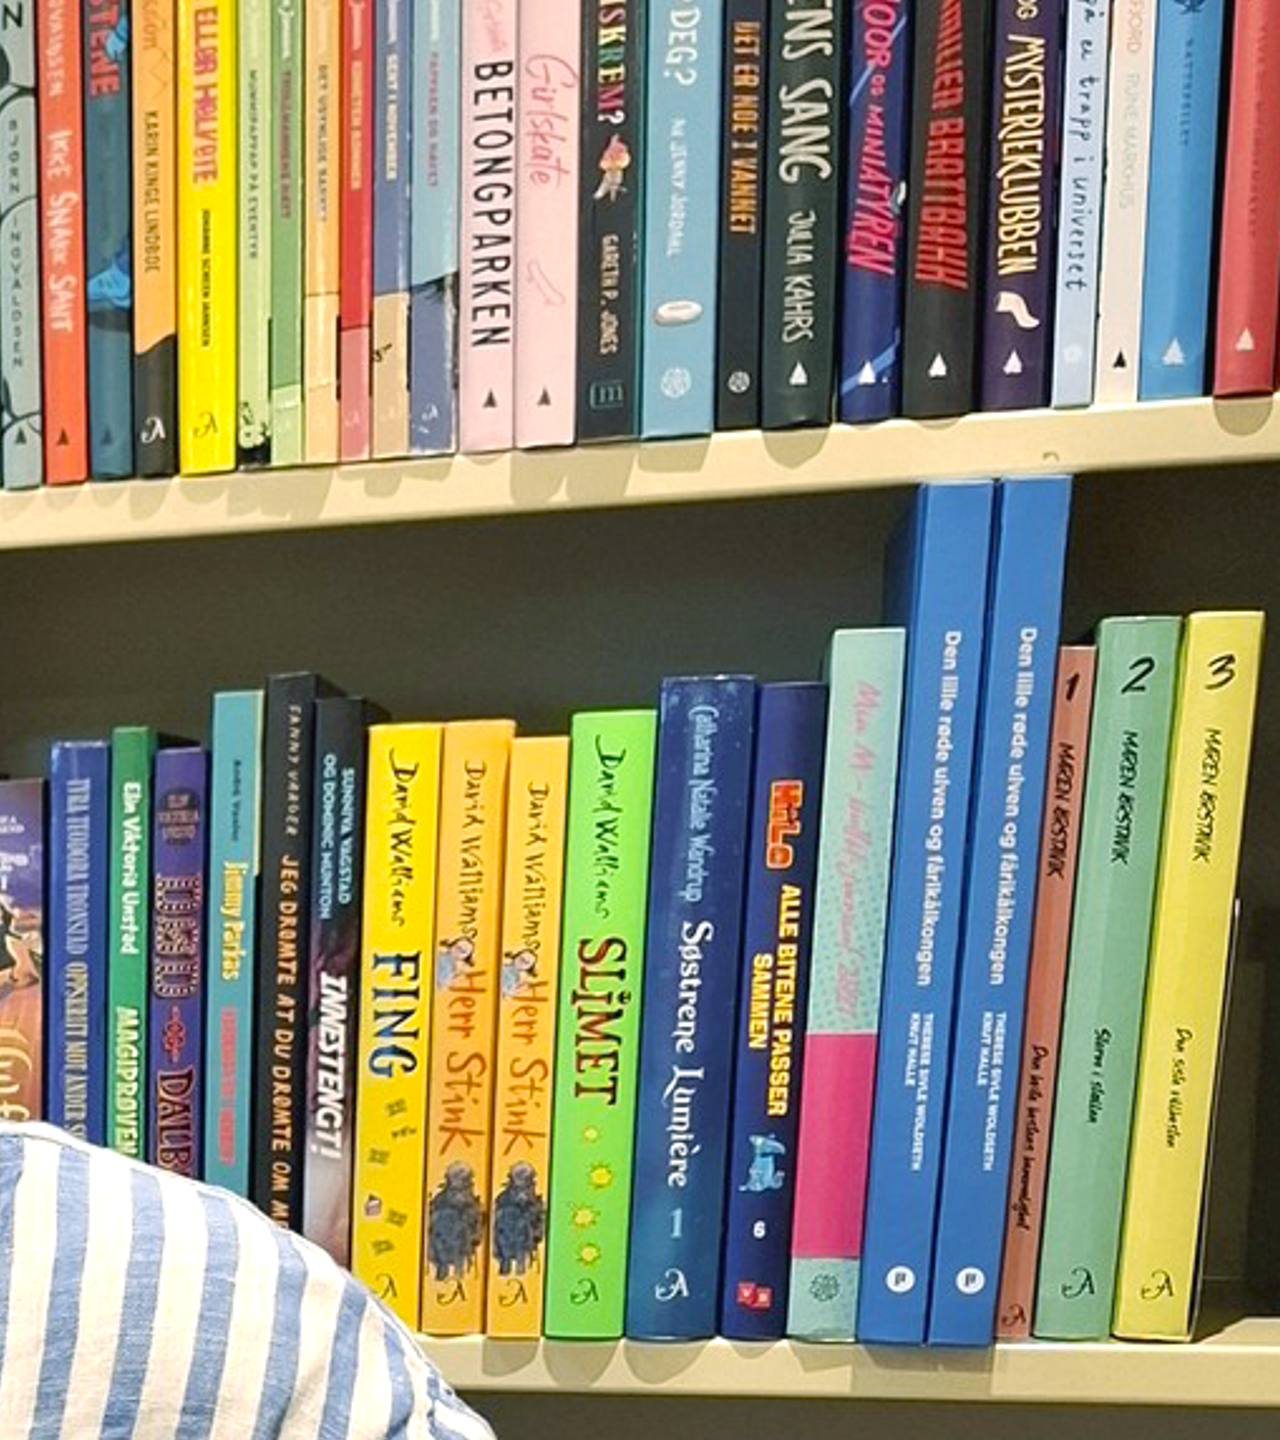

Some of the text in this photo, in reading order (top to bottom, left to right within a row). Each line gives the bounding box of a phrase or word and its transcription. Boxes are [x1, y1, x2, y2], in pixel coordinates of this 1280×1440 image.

[663, 11, 702, 87] DEG?
[731, 64, 759, 87] ER
[732, 21, 760, 57] DET
[730, 94, 759, 133] NOE
[778, 78, 832, 184] SANG
[997, 34, 1046, 277] MYSTERIEKLUBBEN
[47, 130, 77, 333] IKKE SNAKK SANT
[143, 110, 160, 273] KARIN KINGE LINDBOE
[472, 60, 514, 347] BETONGPARKEN
[729, 158, 757, 235] VANNET
[782, 209, 817, 343] JULIA KAHRS
[1064, 672, 1082, 700] 1
[1121, 655, 1155, 696] 2
[1204, 653, 1237, 692] 3
[916, 630, 963, 988] Den lille røde ulven og fårikålkongen
[120, 782, 142, 955] Elin Viktoria Unstad
[223, 861, 249, 917] Jimmy
[221, 919, 246, 981] Parkas
[748, 951, 773, 1050] SAMMEN
[767, 884, 802, 1118] ALLE BITENE PASSER
[270, 855, 301, 1192] JEG DRØMTE AT DU DRØMTE OM
[313, 971, 348, 1159] INNESTENGT!
[369, 951, 423, 1079] FING
[439, 970, 488, 1156] Herr Stink
[666, 919, 717, 1190] Søstrene Lumière
[751, 1218, 767, 1239] 6
